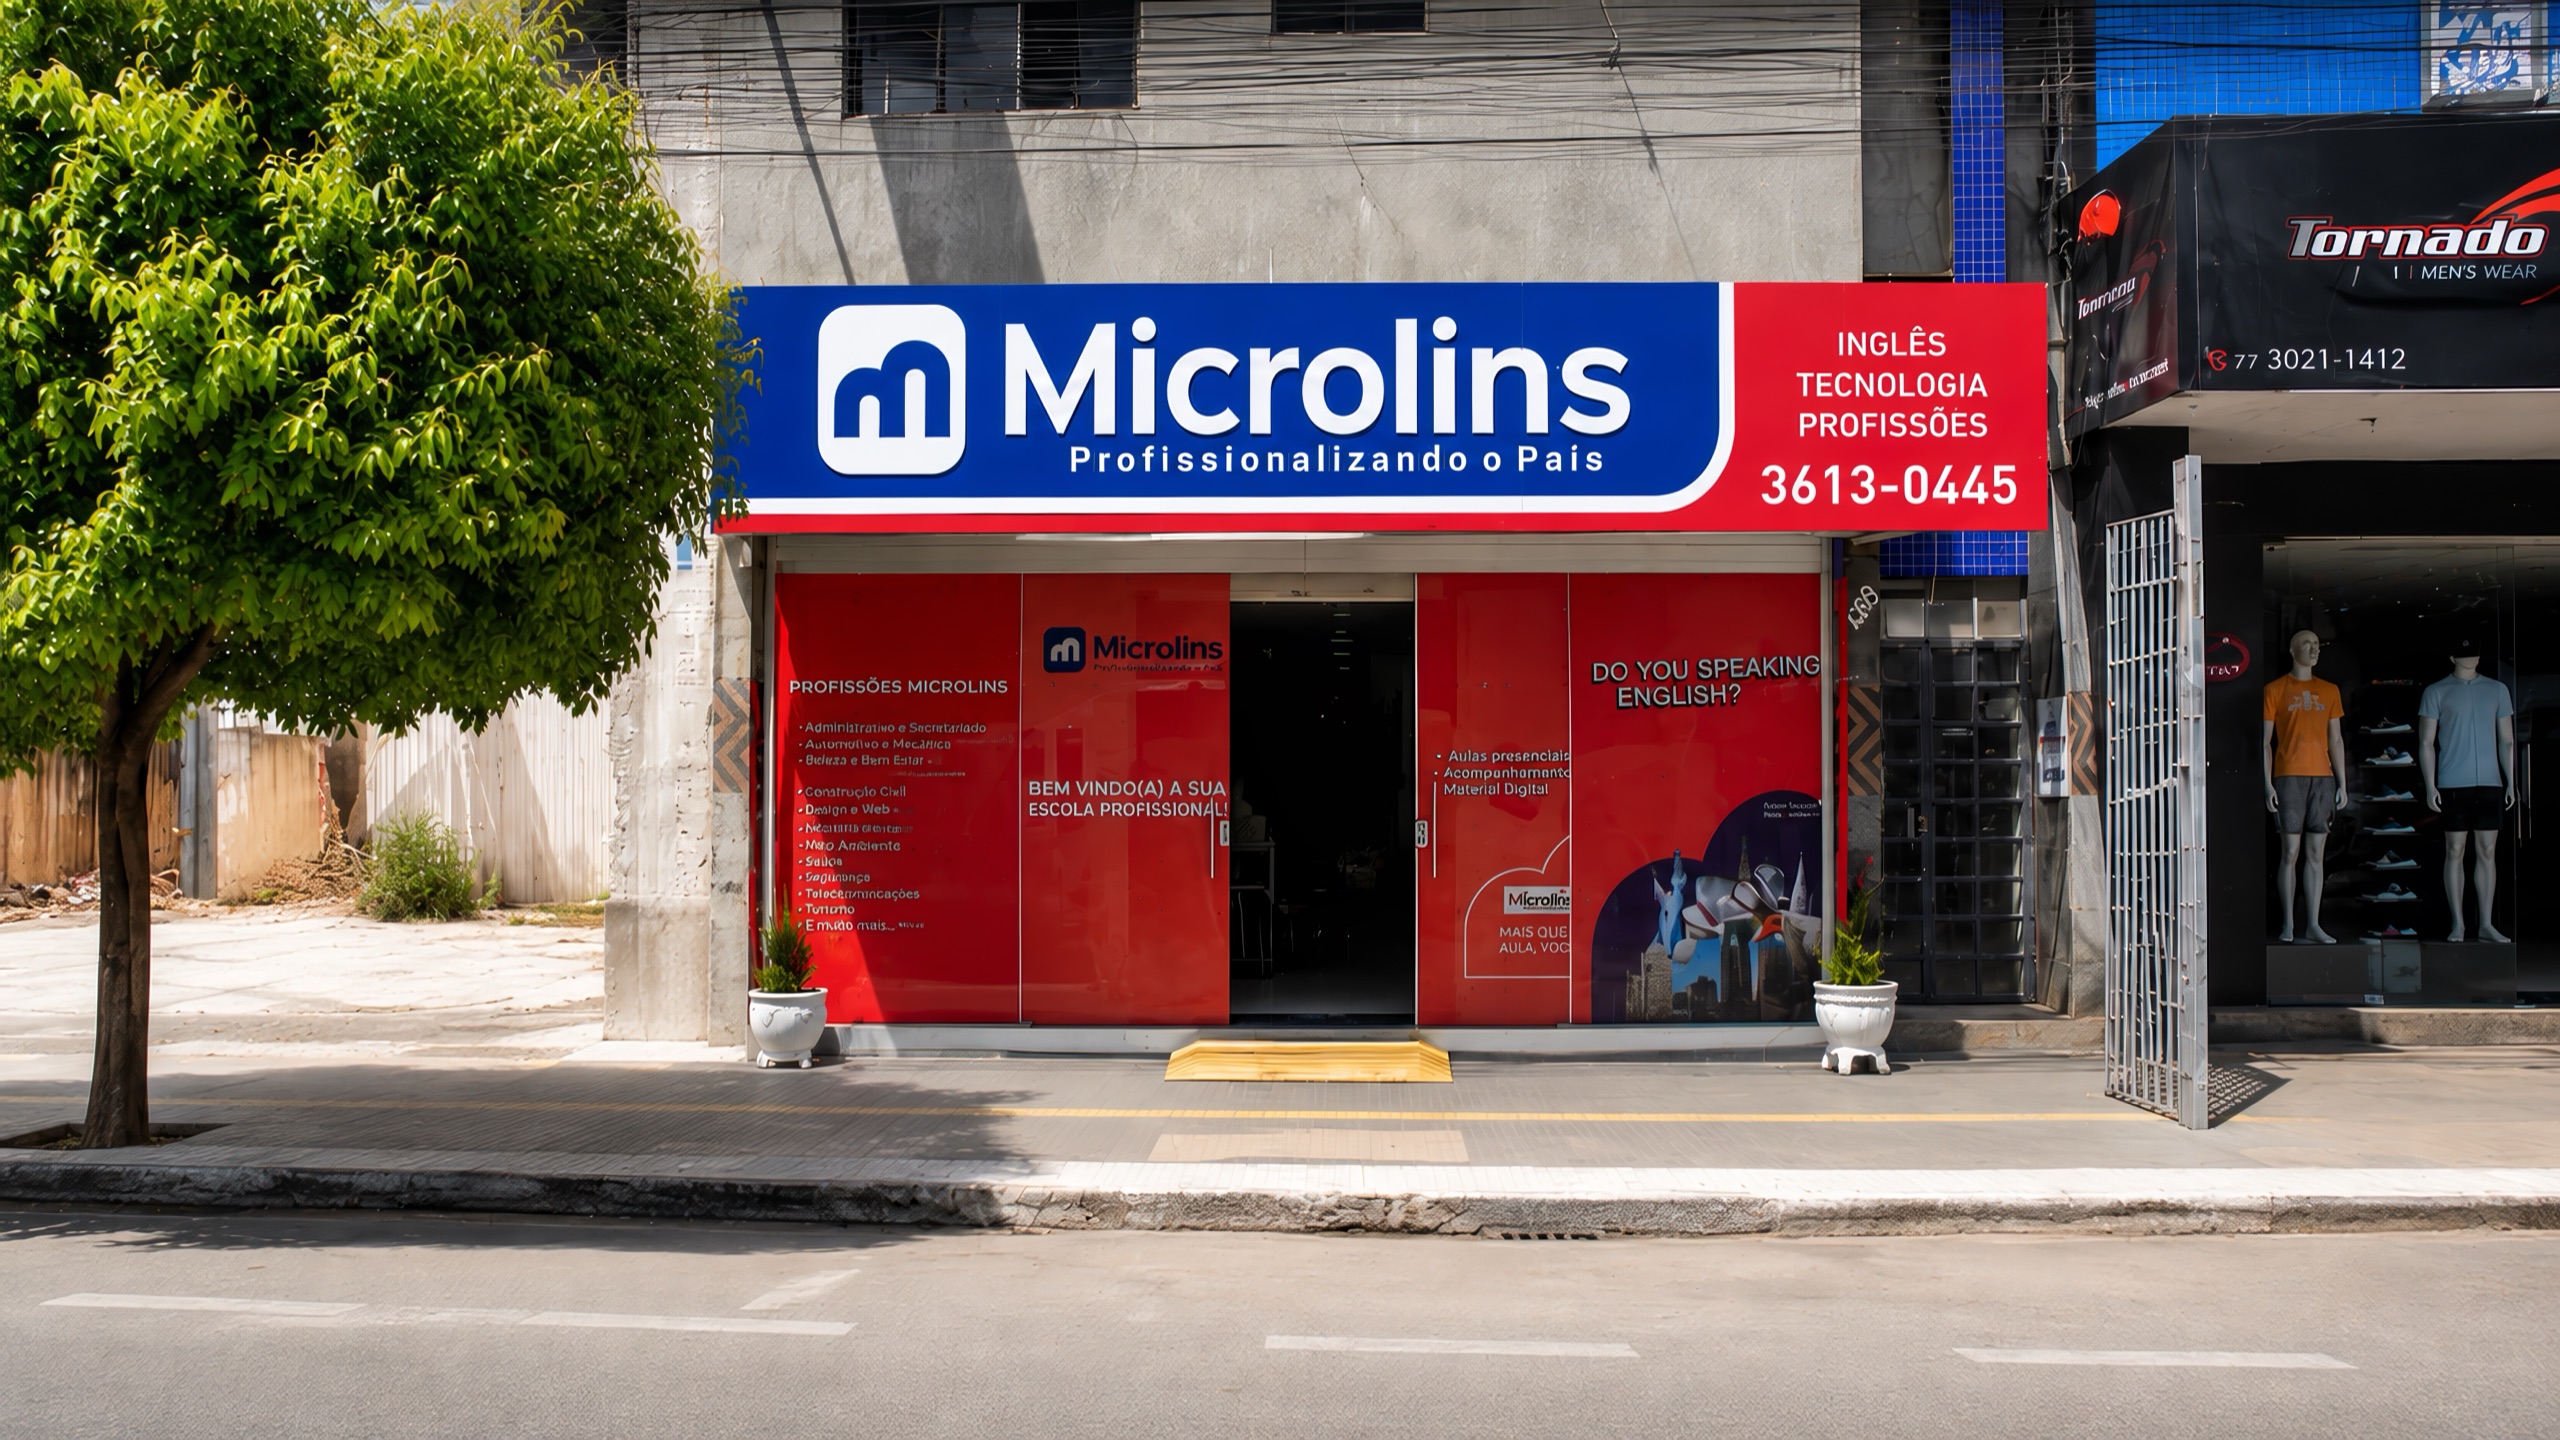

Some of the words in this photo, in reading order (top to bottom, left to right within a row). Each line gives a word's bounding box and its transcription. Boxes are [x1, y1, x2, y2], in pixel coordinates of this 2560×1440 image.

[2287, 215, 2547, 260] Tornado
[2421, 264, 2477, 280] MEN'S
[2483, 264, 2537, 280] WEAR
[1838, 326, 1948, 357] INGLÊS
[2234, 354, 2258, 370] 77
[2267, 347, 2406, 370] 3021-1412
[1005, 316, 1632, 437] Microlins
[1796, 372, 1988, 399] TECNOLOGIA
[1798, 406, 1988, 438] PROFISSÕES
[1070, 444, 1468, 473] Profissionalizando
[1483, 450, 1501, 472] o
[1517, 443, 1605, 473] País
[1760, 463, 2019, 506] 3613-0445
[1093, 635, 1223, 660] Microlins
[1592, 661, 1628, 683] DO
[1637, 659, 1689, 682] YOU
[1697, 655, 1820, 680] SPEAKING
[789, 677, 902, 694] PROFISSÕES
[908, 680, 1008, 694] MICROLINS
[1617, 683, 1742, 708] ENGLISH?
[1448, 750, 1487, 762] Aulas
[1029, 780, 1070, 796] BEM
[1076, 779, 1163, 799] VINDO(A)
[1169, 780, 1182, 796] A
[1188, 780, 1226, 797] SUA
[1444, 782, 1499, 795] Material
[1504, 782, 1549, 798] Digital
[861, 804, 890, 815] Web
[1029, 802, 1094, 817] ESCOLA
[1100, 801, 1228, 818] PROFISSIONAL!
[805, 919, 814, 931] E
[1499, 926, 1534, 938] MAIS
[1538, 926, 1567, 938] QUE
[1499, 942, 1537, 955] AULA,
